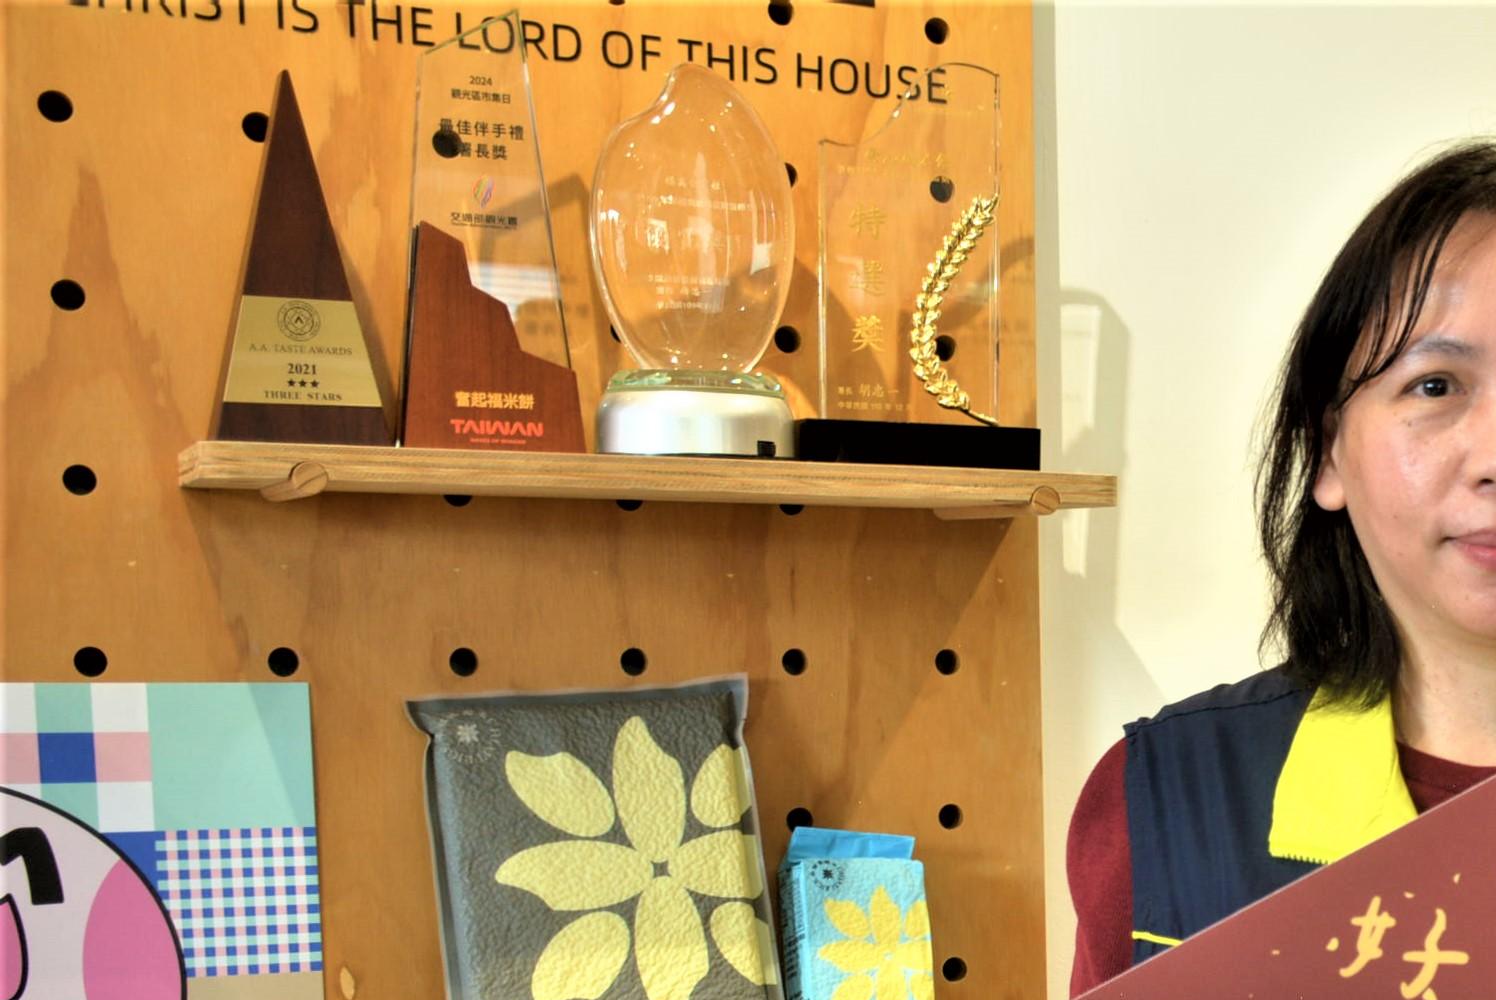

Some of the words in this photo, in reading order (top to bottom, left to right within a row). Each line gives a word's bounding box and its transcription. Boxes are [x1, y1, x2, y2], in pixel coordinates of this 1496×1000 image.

[277, 0, 320, 33] IS
[343, 3, 436, 47] THE
[455, 13, 583, 63] LORD
[601, 31, 661, 71] OF
[677, 37, 779, 84] THIS
[797, 53, 948, 104] HOUSE
[469, 75, 493, 86] 2024
[287, 362, 318, 376] 2021
[263, 389, 301, 400] THREE
[307, 392, 343, 401] STARS
[450, 419, 544, 436] TAIWAN
